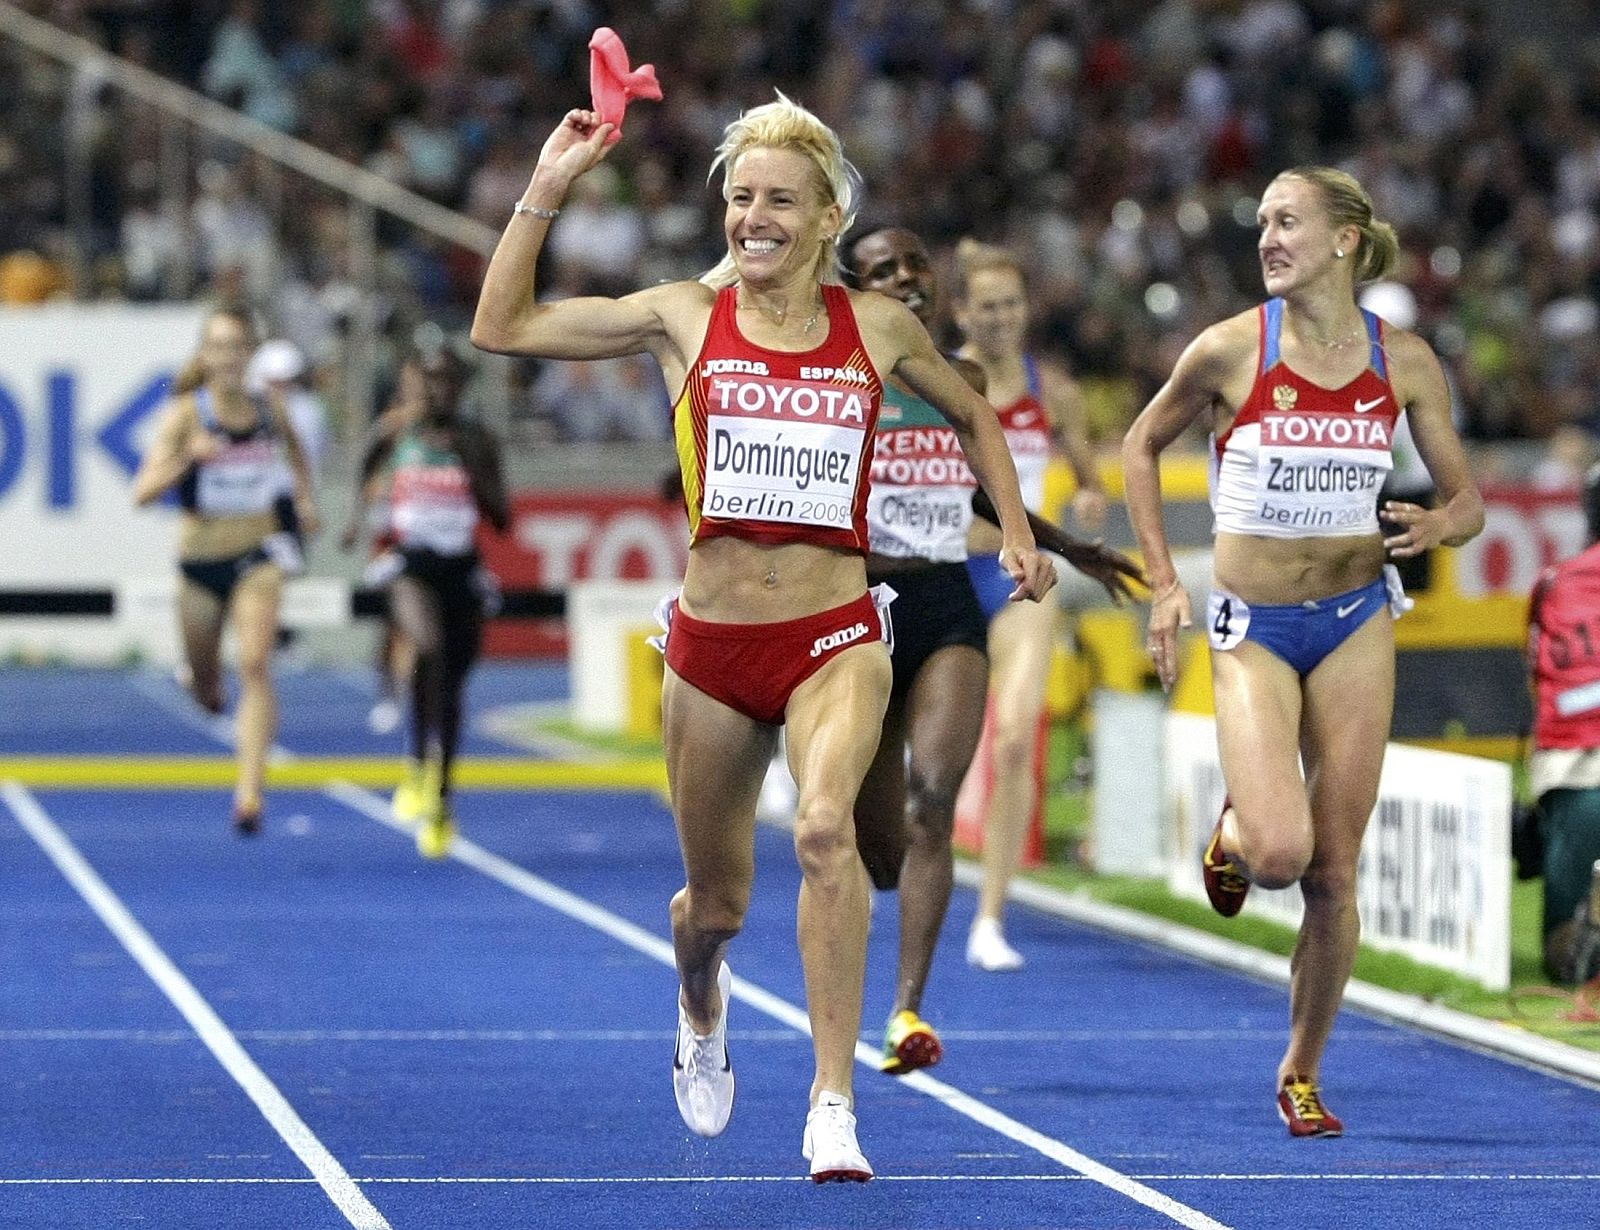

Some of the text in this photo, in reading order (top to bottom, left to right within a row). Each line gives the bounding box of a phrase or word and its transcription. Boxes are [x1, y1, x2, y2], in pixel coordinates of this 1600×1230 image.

[800, 366, 868, 384] ESPAÑA
[715, 378, 864, 423] TOYOTA
[1263, 416, 1388, 445] TOYOTA
[714, 428, 851, 490] Domínguez
[1267, 456, 1377, 492] Zarudneva
[709, 488, 852, 524] berlin 2009
[1260, 501, 1333, 525] berlin
[1213, 598, 1233, 643] 4
